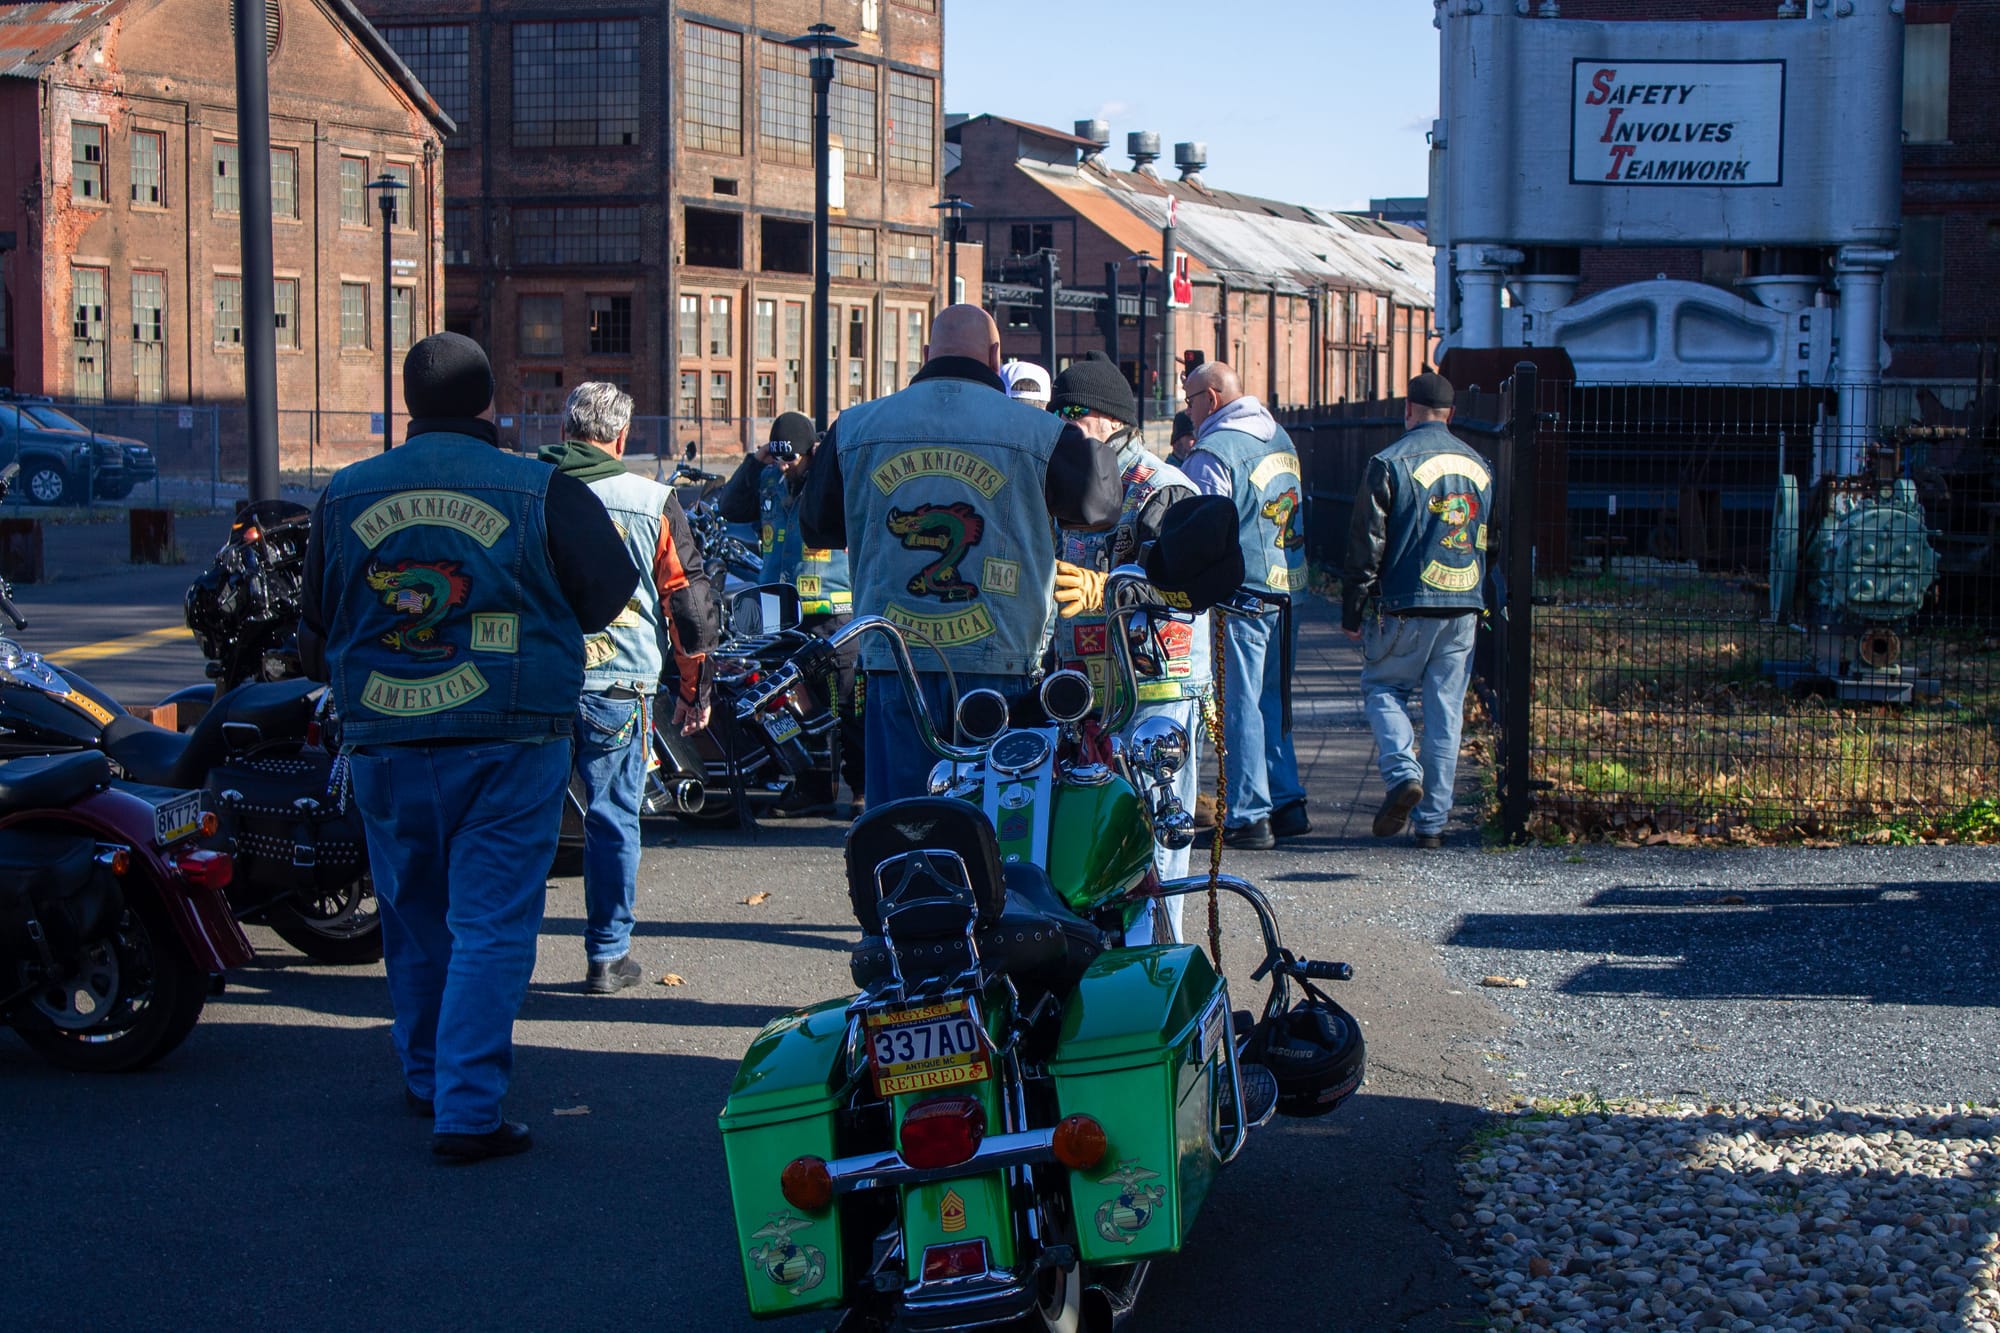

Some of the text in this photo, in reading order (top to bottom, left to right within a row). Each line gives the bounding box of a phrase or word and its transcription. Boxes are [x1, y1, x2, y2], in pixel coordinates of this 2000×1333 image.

[1585, 69, 1696, 105] SAFETY
[1599, 108, 1734, 143] INVOLVES
[1605, 145, 1750, 180] TEAMWORK
[878, 451, 998, 491] NAM KNIGHTS
[361, 497, 497, 539] NAM KNIGHTS
[800, 581, 816, 592] PA
[989, 563, 1013, 587] MC
[480, 621, 510, 643] MC
[369, 673, 477, 709] AMERICA
[883, 1067, 966, 1093] RETIRED
[905, 1056, 956, 1071] ANTIQUE MC
